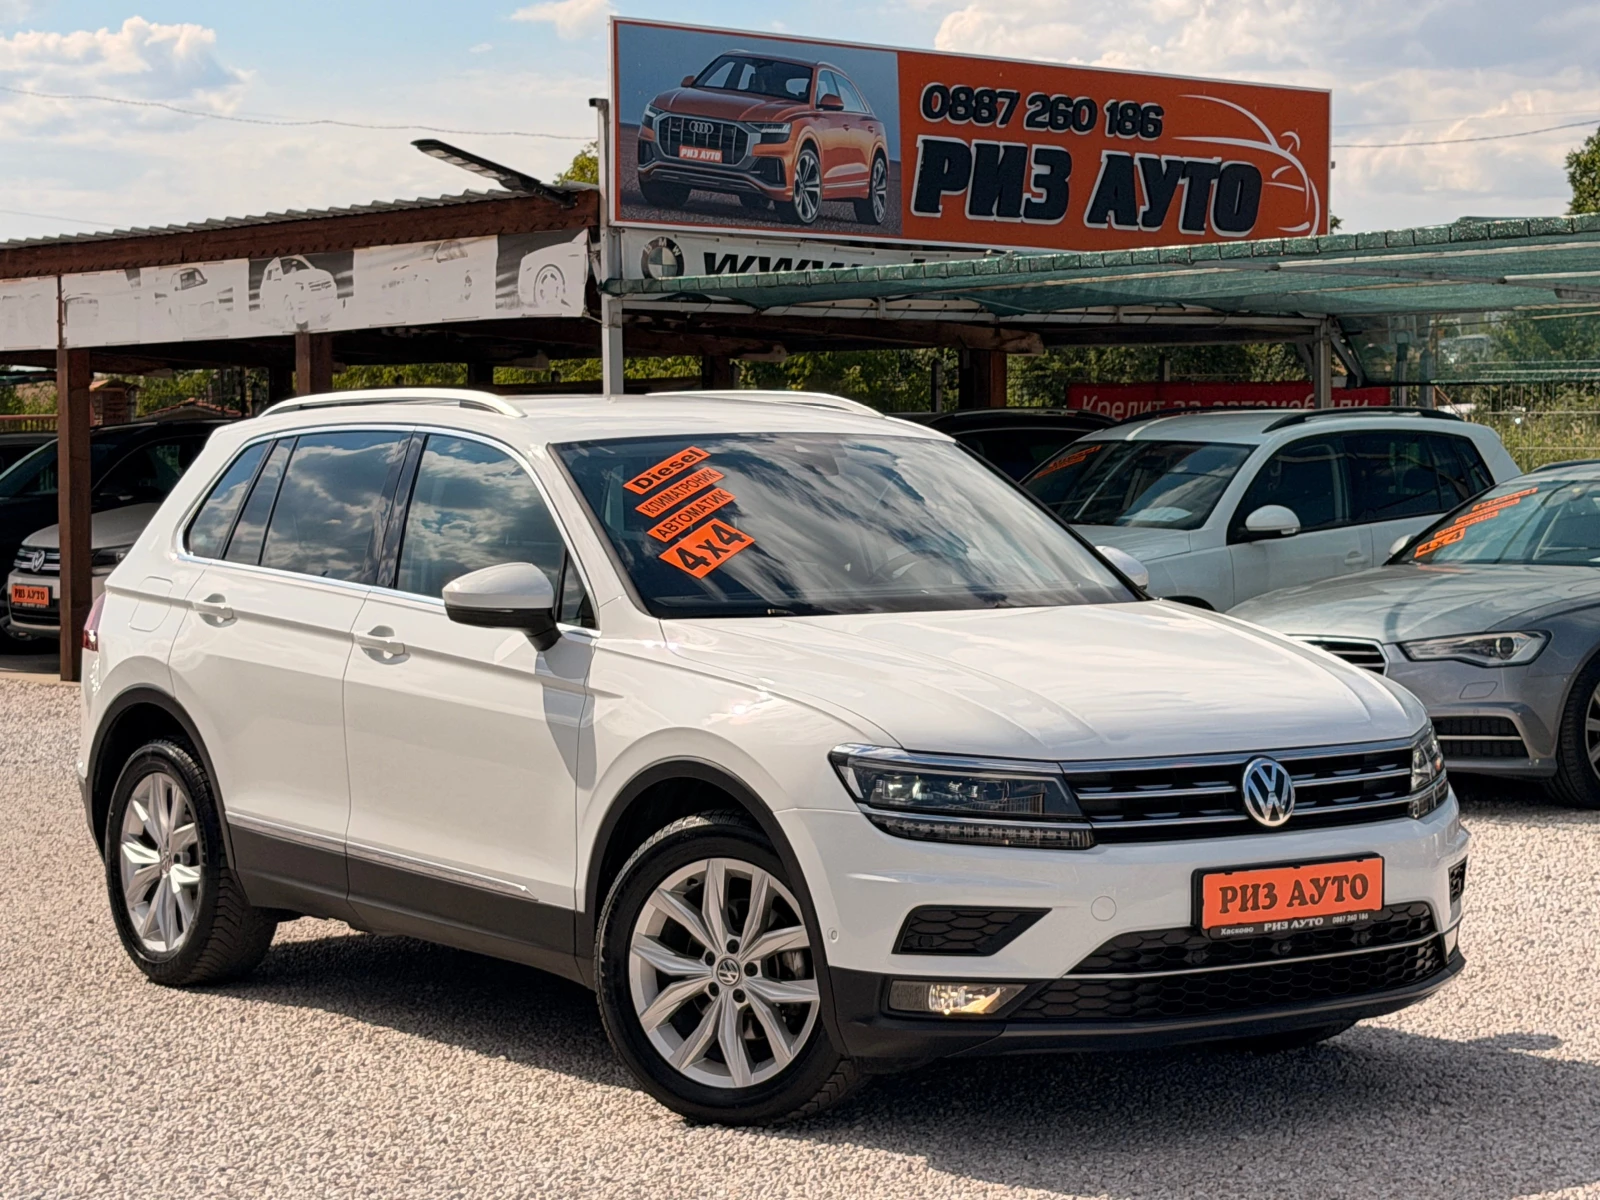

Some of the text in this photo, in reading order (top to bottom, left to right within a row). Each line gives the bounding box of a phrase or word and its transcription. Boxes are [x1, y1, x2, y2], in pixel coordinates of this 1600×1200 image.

[921, 83, 1165, 139] 0887 260 186
[911, 135, 1263, 236] РИЗ АУТО
[632, 449, 704, 490] Diesel
[642, 469, 720, 514] КЛИМАТРОНИК
[656, 490, 731, 538] АВТОМАТИК
[1219, 873, 1369, 914] РИЗ АУТО
[1220, 926, 1255, 936] Хасково
[1263, 921, 1289, 931] РИЗ
[1290, 917, 1324, 930] АУТО
